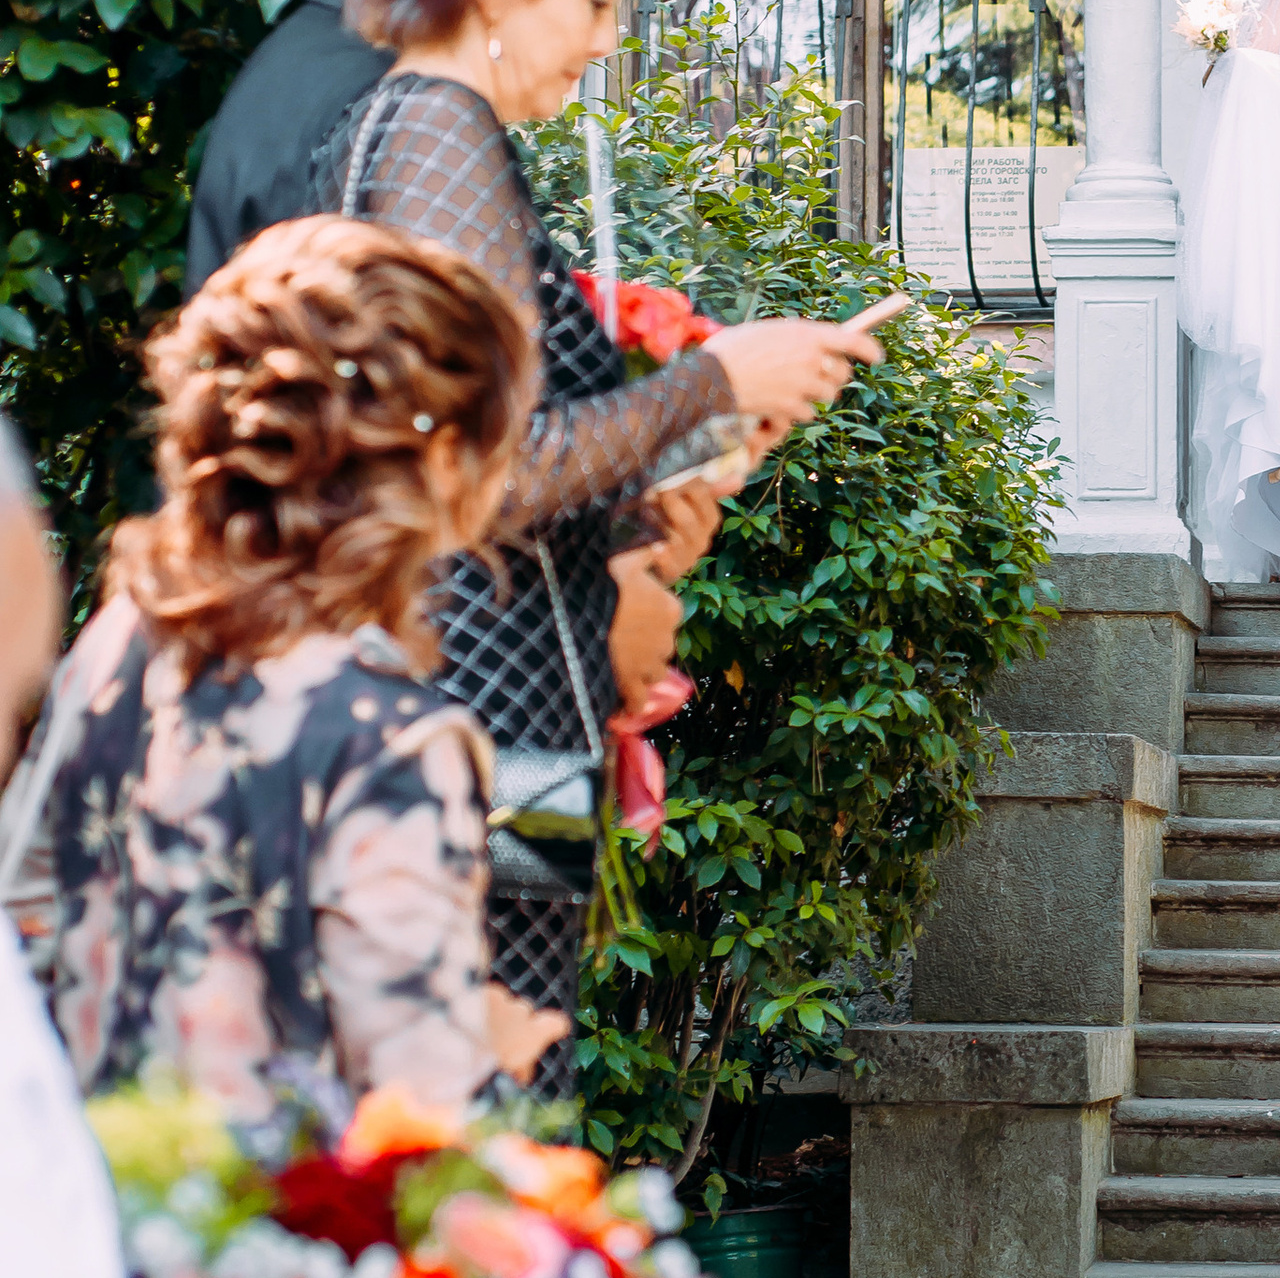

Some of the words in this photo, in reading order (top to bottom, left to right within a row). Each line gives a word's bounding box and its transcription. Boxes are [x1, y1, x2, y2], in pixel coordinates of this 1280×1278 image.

[954, 158, 985, 167] РЕИМ
[987, 158, 1025, 166] РАБОТЫ
[930, 167, 988, 176] ЯЛТИНСОГО
[990, 167, 1048, 175] ГОРОДСКГО
[958, 177, 992, 186] ОДЕЛА
[997, 177, 1019, 185] ЗАГС
